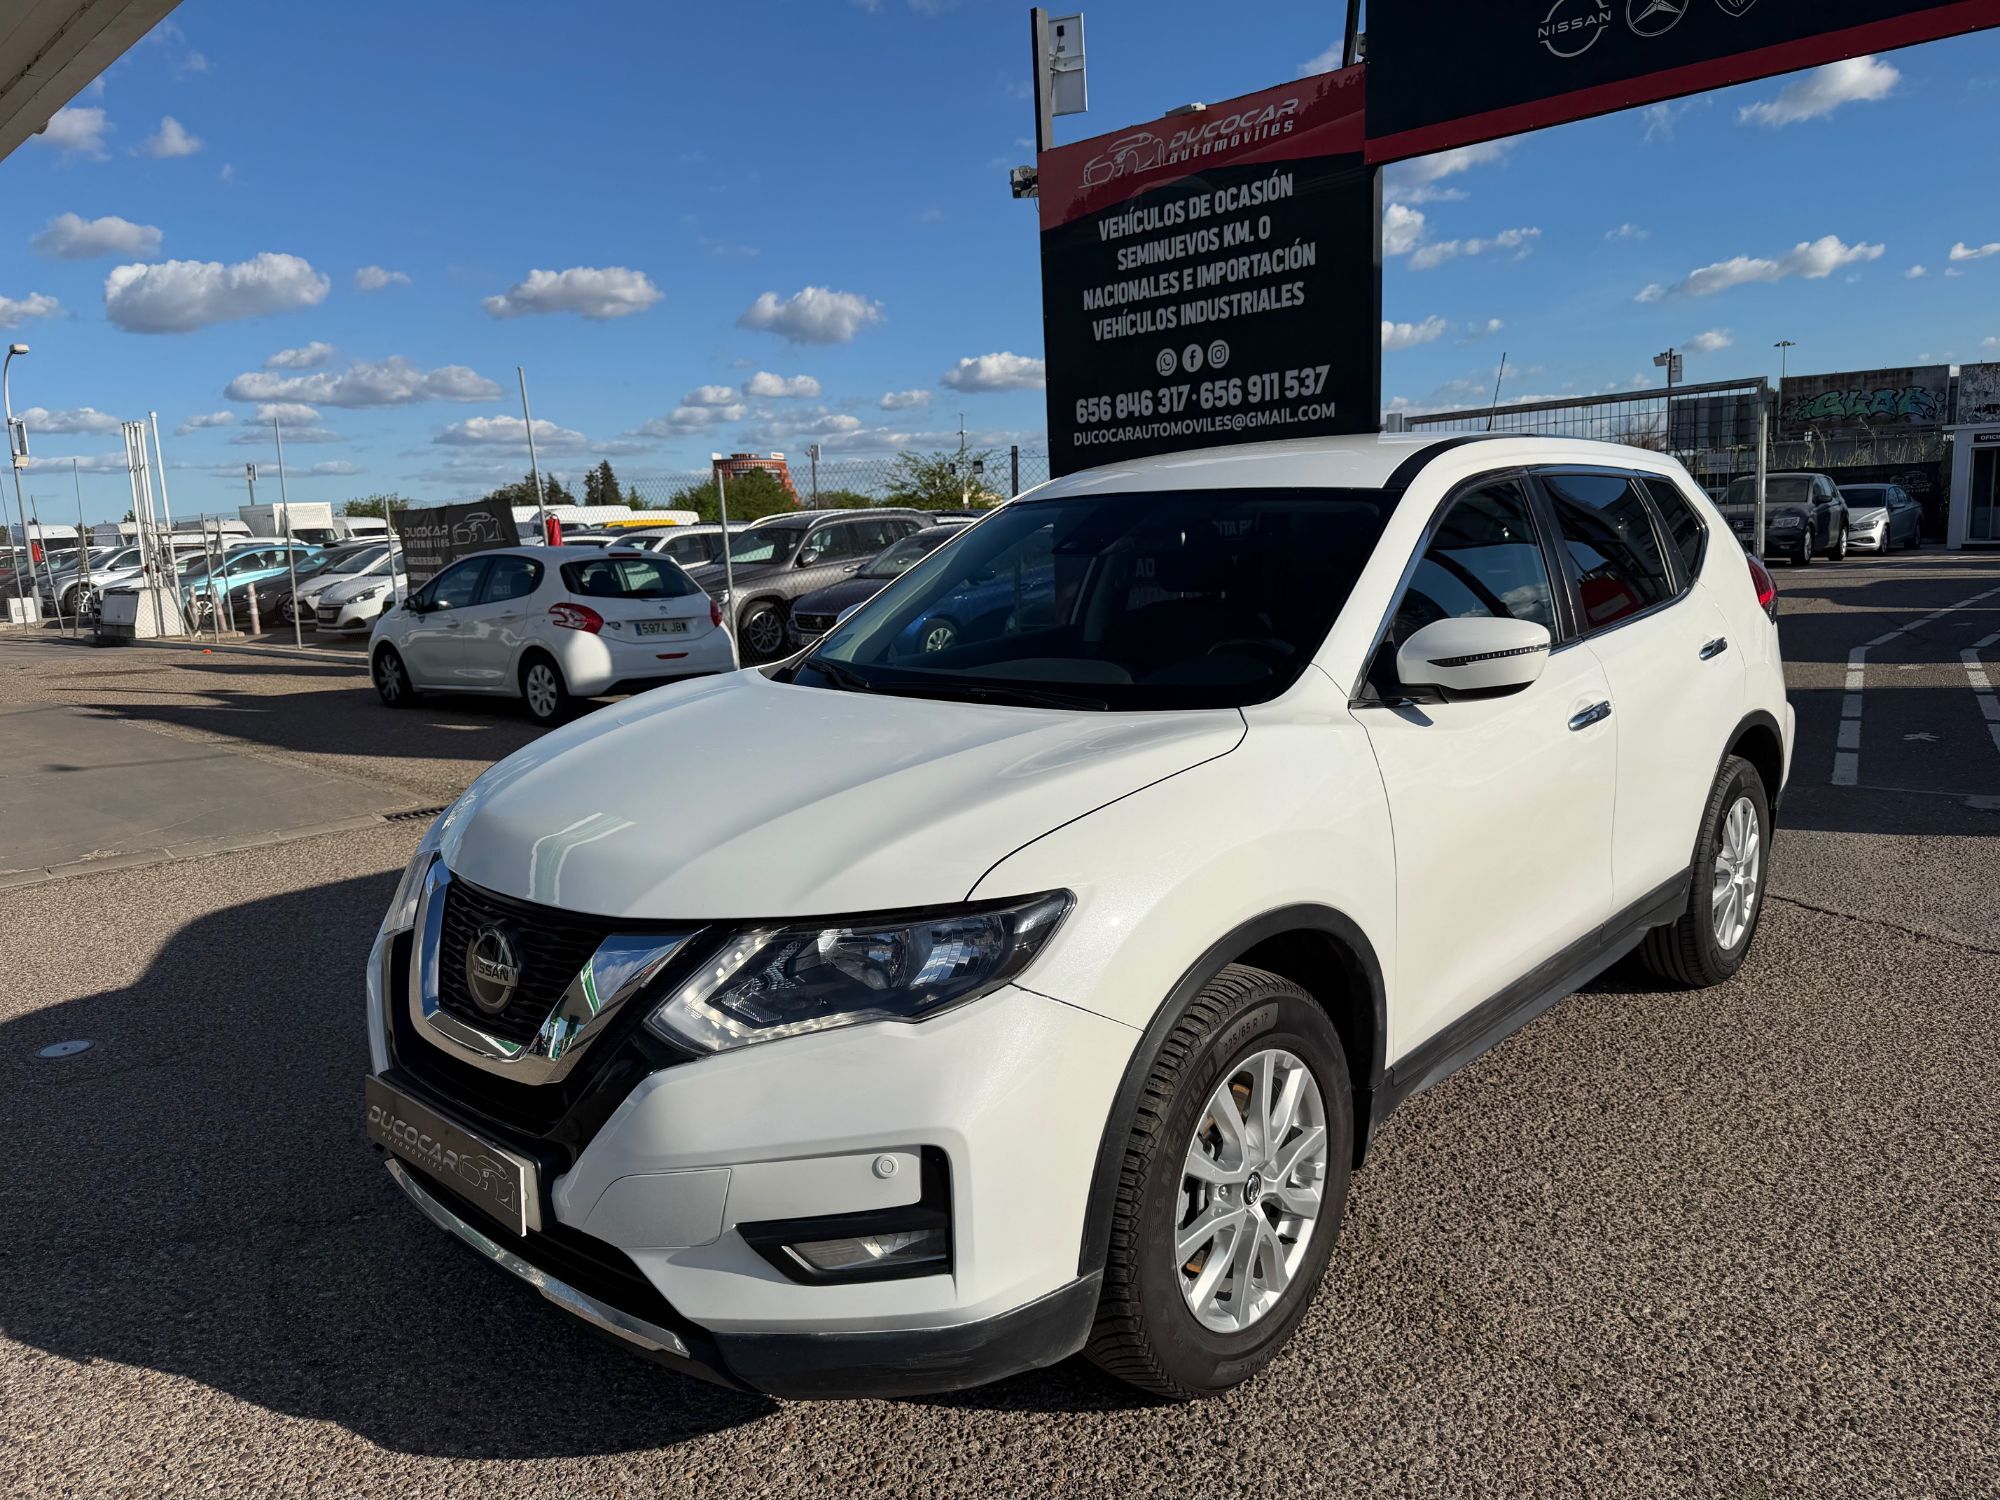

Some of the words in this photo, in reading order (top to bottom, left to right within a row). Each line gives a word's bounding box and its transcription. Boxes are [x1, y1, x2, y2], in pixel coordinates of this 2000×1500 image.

[1538, 10, 1612, 38] NISSAN
[1168, 98, 1299, 149] DUCOCAR
[1098, 200, 1185, 242] VEHÍCULOS
[1189, 194, 1212, 221] DE
[1214, 169, 1293, 214] OCASIÓN
[1117, 227, 1220, 271] SEMINUEVOS
[1223, 219, 1254, 247] KM.
[1083, 271, 1179, 311] NACIONALES
[1182, 268, 1194, 291] E
[1196, 237, 1316, 288] IMPORTACIÓN
[1092, 305, 1177, 341] VEHÍCULOS
[1180, 281, 1305, 326] INDUSTRIALES
[1075, 395, 1112, 424] 656
[1115, 389, 1153, 419] 846
[1199, 378, 1243, 410] 656
[1247, 372, 1280, 404] 911
[1284, 364, 1331, 399] 537
[1073, 402, 1336, 446] DUCOCARAUTOMOVILES@GMAIL.COM
[404, 524, 449, 538] DUCOCAR
[641, 622, 668, 634] 5974
[472, 957, 509, 982] NISSAN
[368, 1105, 460, 1172] DUCOCAR
